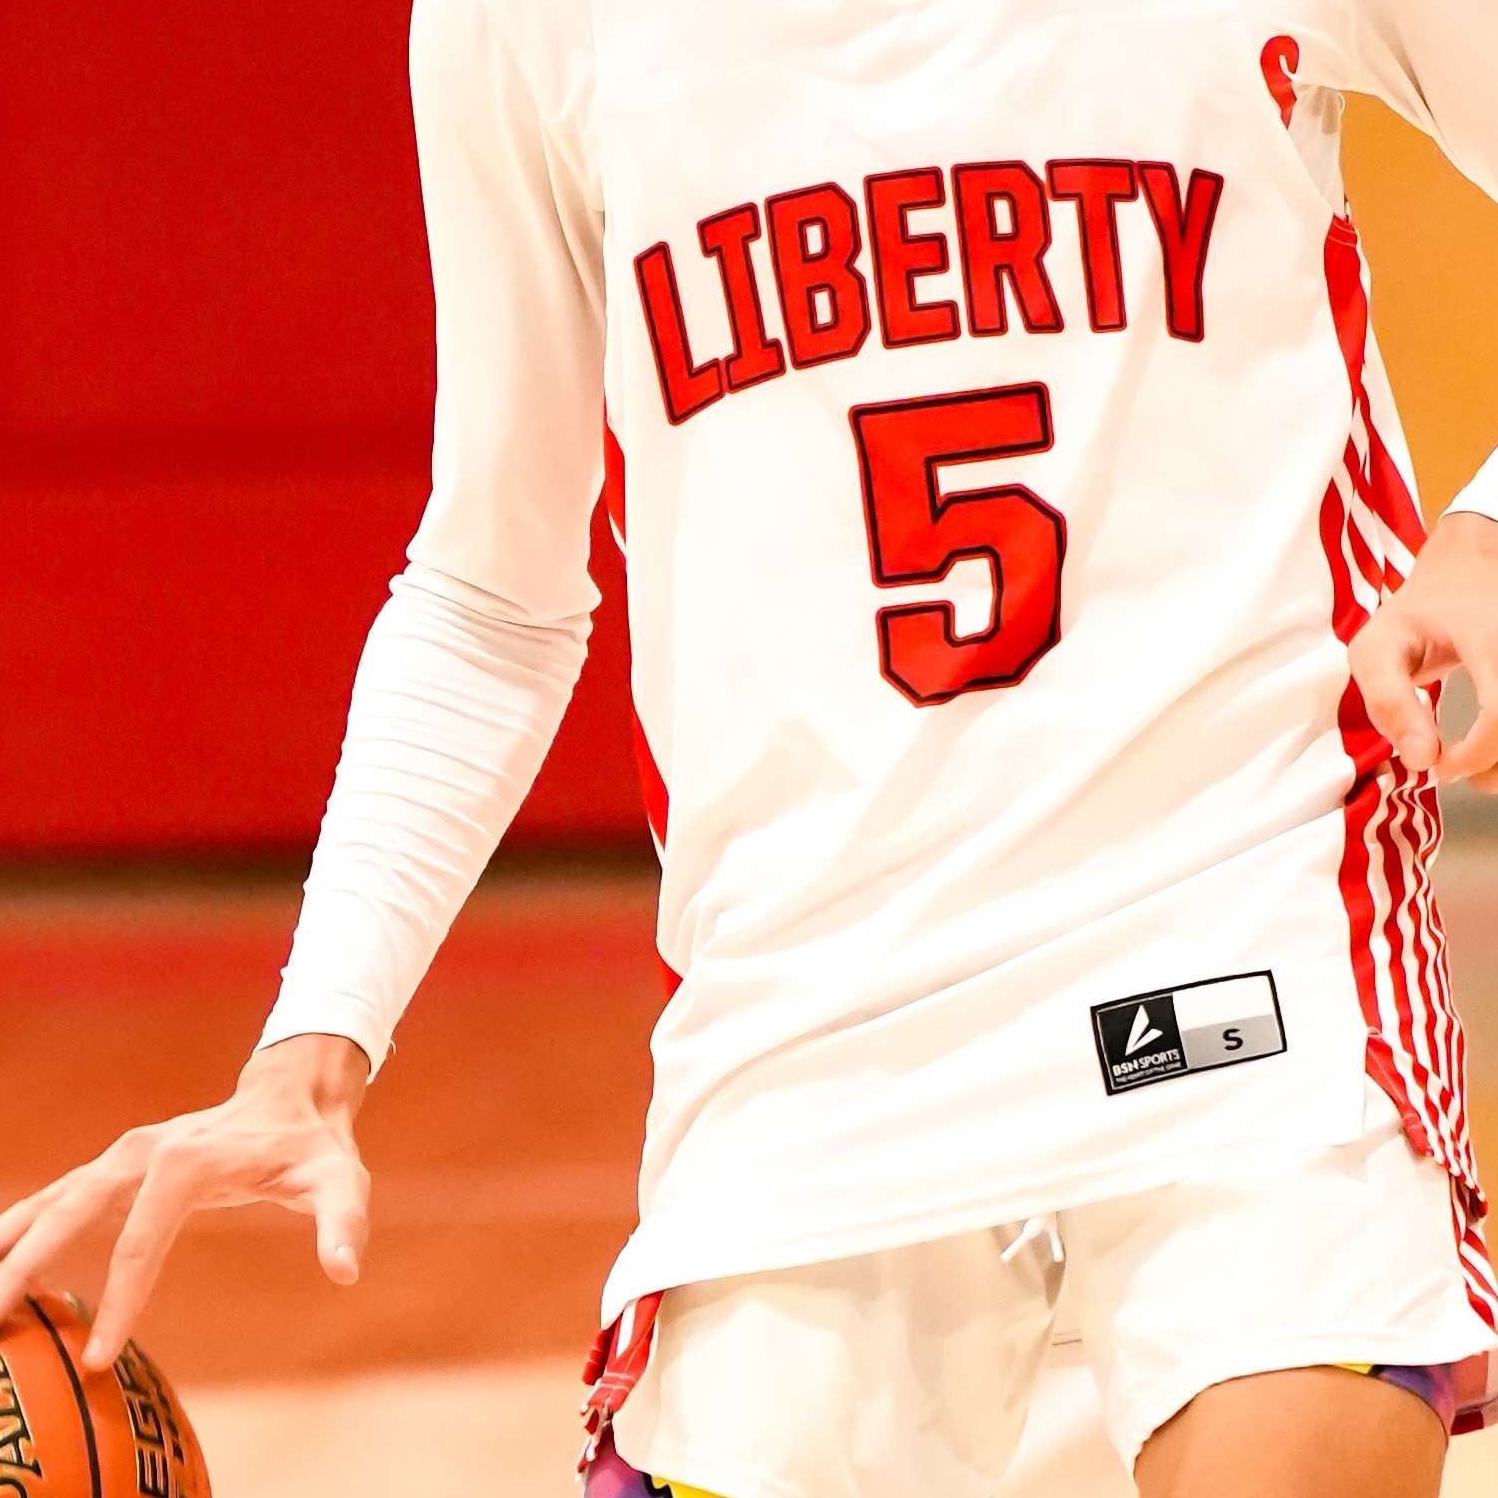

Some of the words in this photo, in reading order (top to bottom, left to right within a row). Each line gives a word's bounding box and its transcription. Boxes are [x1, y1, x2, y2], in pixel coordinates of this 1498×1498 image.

[633, 158, 1223, 425] LIBERTY
[849, 382, 1067, 708] 5
[1139, 1048, 1181, 1069] SPORTS
[1222, 1028, 1243, 1051] S
